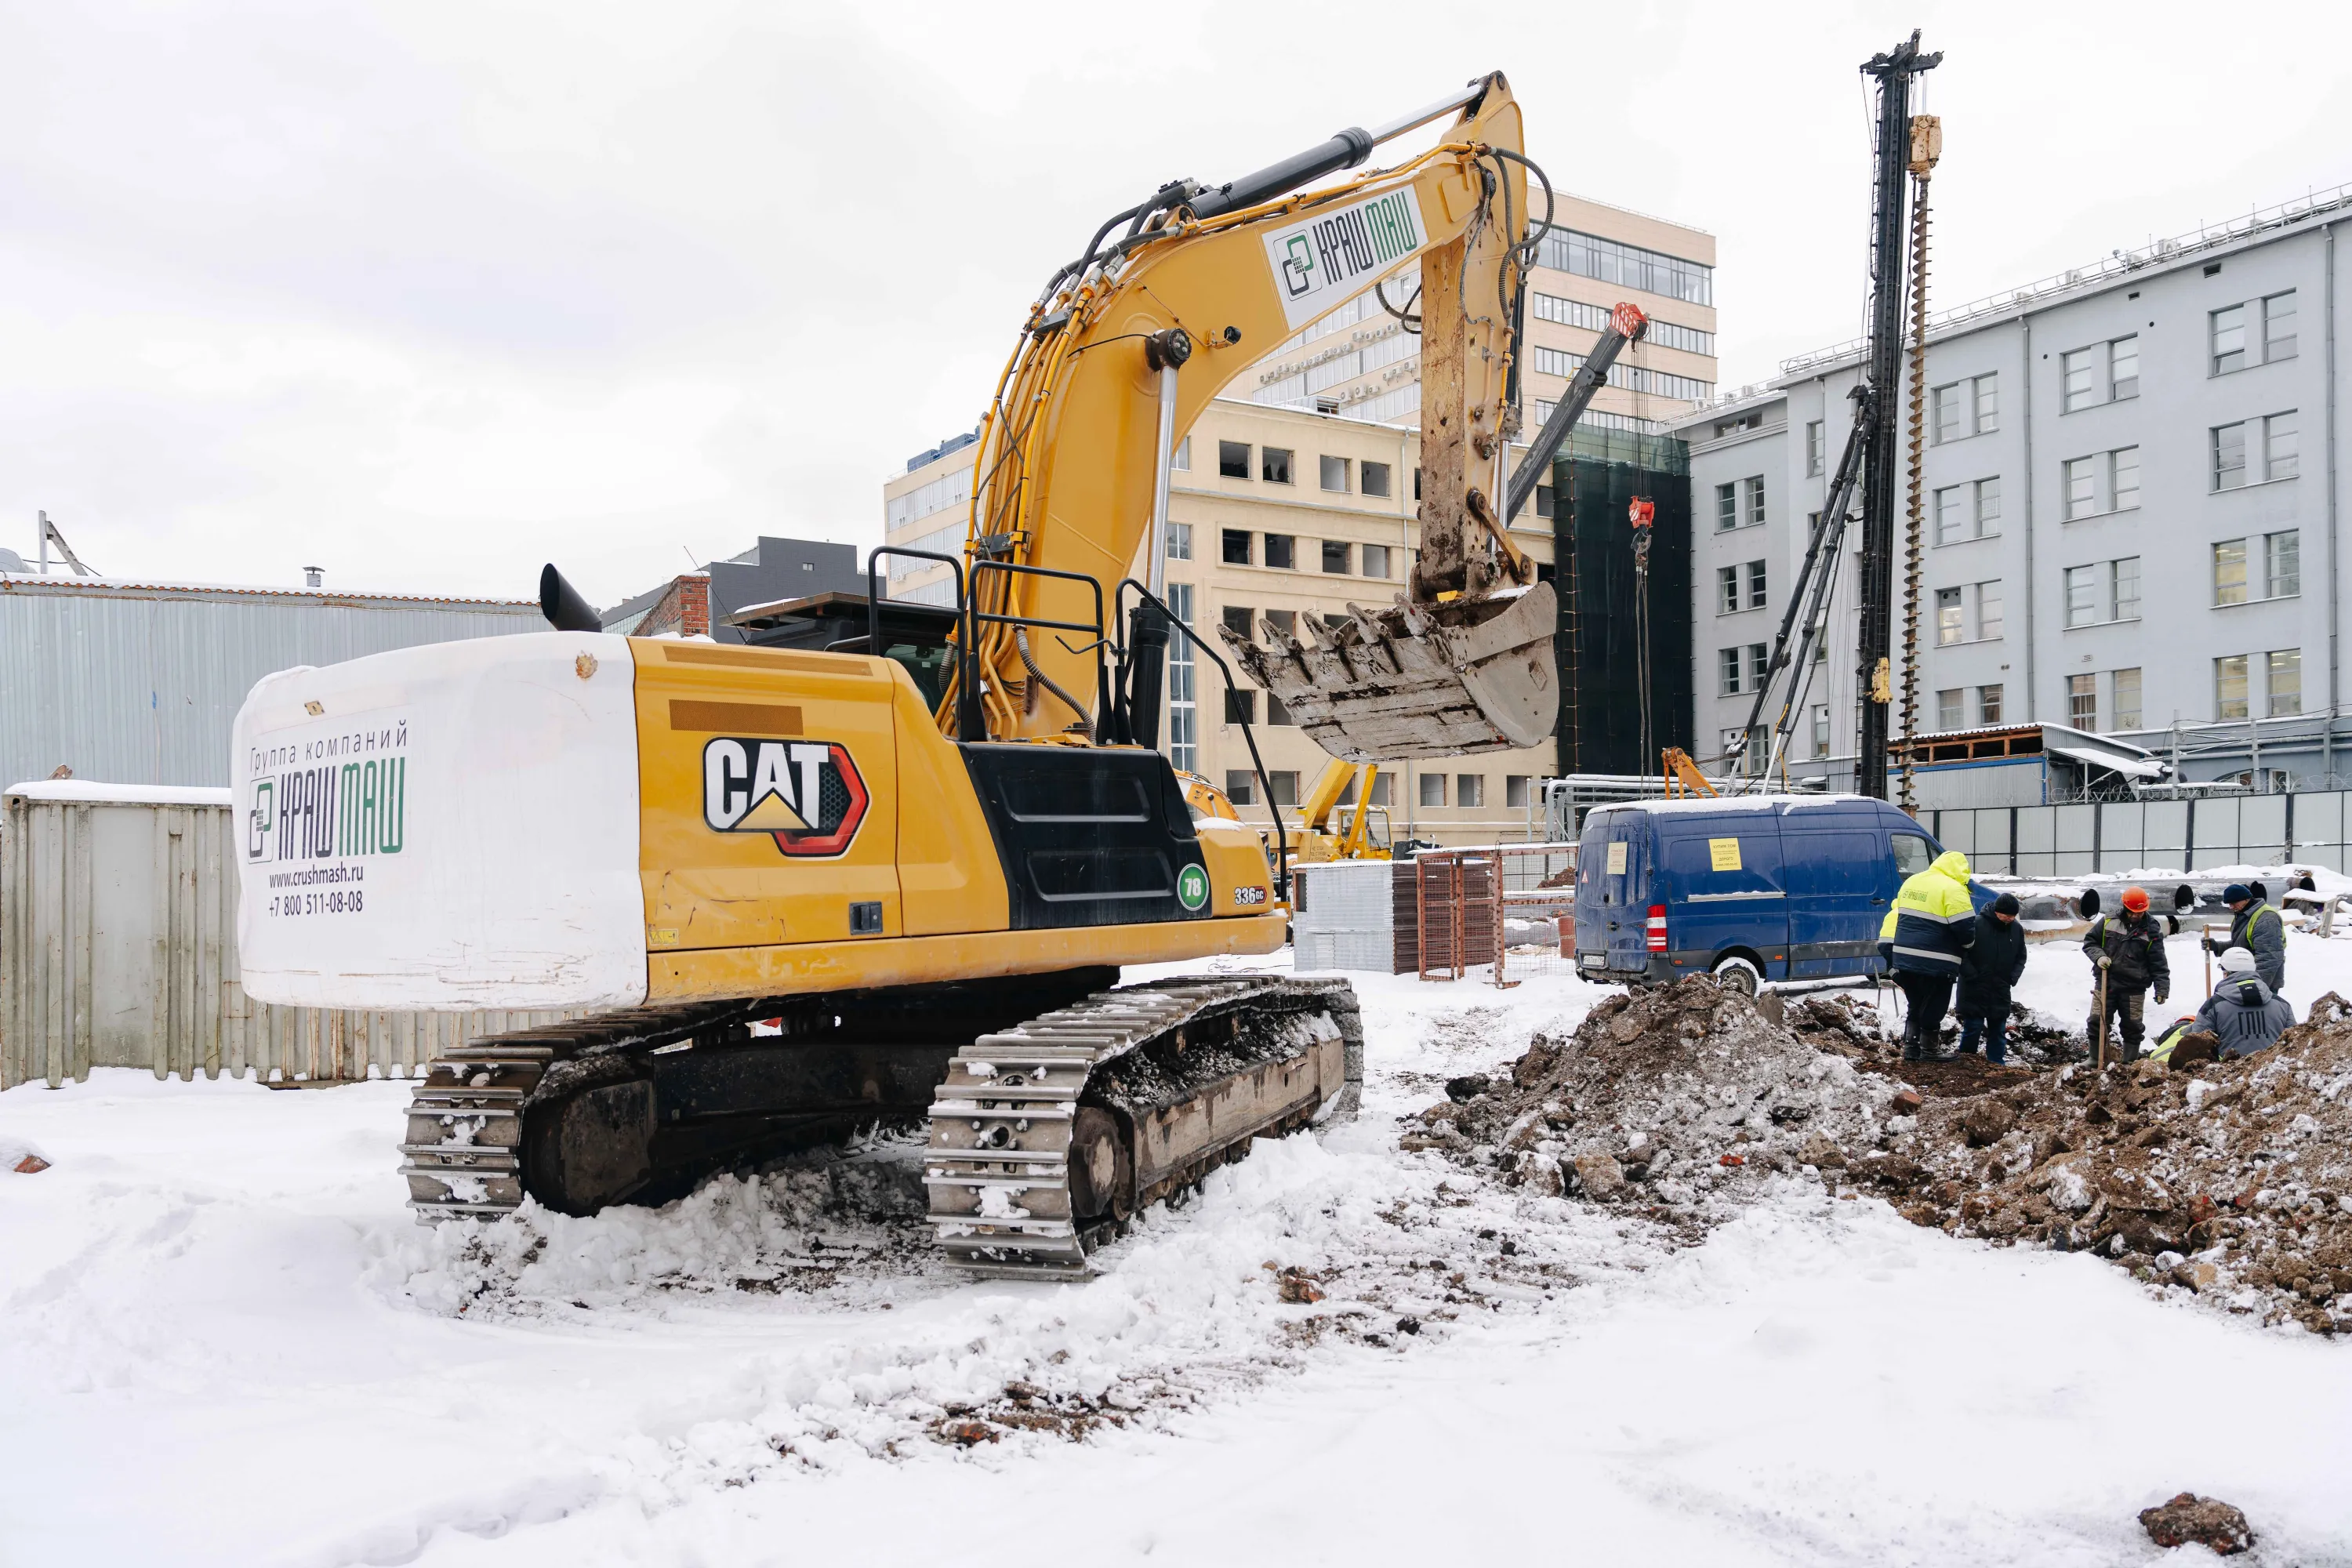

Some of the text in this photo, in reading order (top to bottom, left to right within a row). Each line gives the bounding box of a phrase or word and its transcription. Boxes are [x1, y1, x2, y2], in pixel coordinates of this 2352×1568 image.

[1312, 191, 1417, 285] КРАШМАШ
[250, 719, 407, 776] Группа компаний
[706, 739, 829, 829] CAT
[278, 757, 405, 860] КРАШМАШ
[269, 862, 364, 888] www.crushmash.ru
[1185, 878, 1202, 897] 78
[269, 891, 363, 916] +7 800 511-08-08
[1235, 887, 1254, 905] 336
